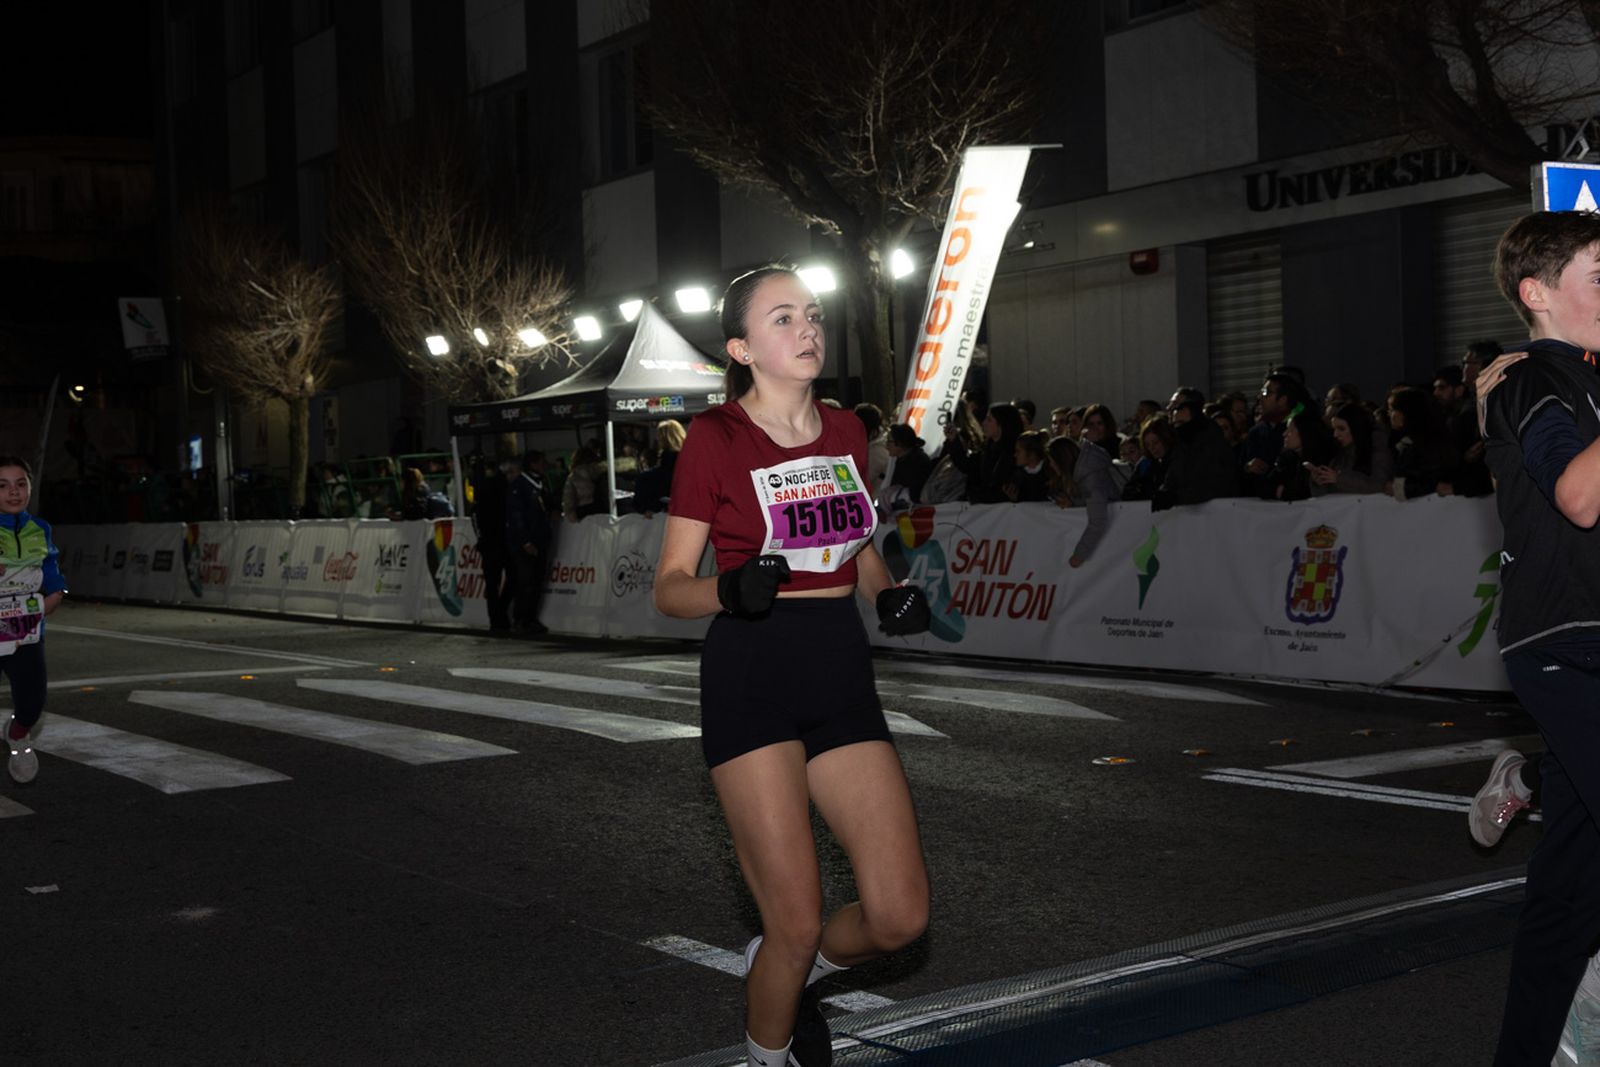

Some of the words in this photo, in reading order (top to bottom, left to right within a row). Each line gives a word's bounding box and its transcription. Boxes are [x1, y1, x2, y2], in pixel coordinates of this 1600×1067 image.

[1243, 150, 1476, 212] UNIVERSID
[707, 393, 727, 405] sup
[937, 363, 963, 427] obras
[785, 470, 819, 486] NOCHE
[819, 469, 831, 480] DE
[775, 487, 799, 502] SAN
[801, 480, 835, 499] ANTÓN
[782, 496, 864, 538] 15165
[759, 559, 778, 567] KIP
[951, 539, 1018, 575] SAN
[945, 572, 1058, 621] ANTÓN
[1132, 617, 1163, 628] Municipal
[1165, 619, 1174, 628] de
[1107, 627, 1136, 638] Deportes
[1138, 629, 1146, 638] de
[1287, 642, 1298, 651] de
